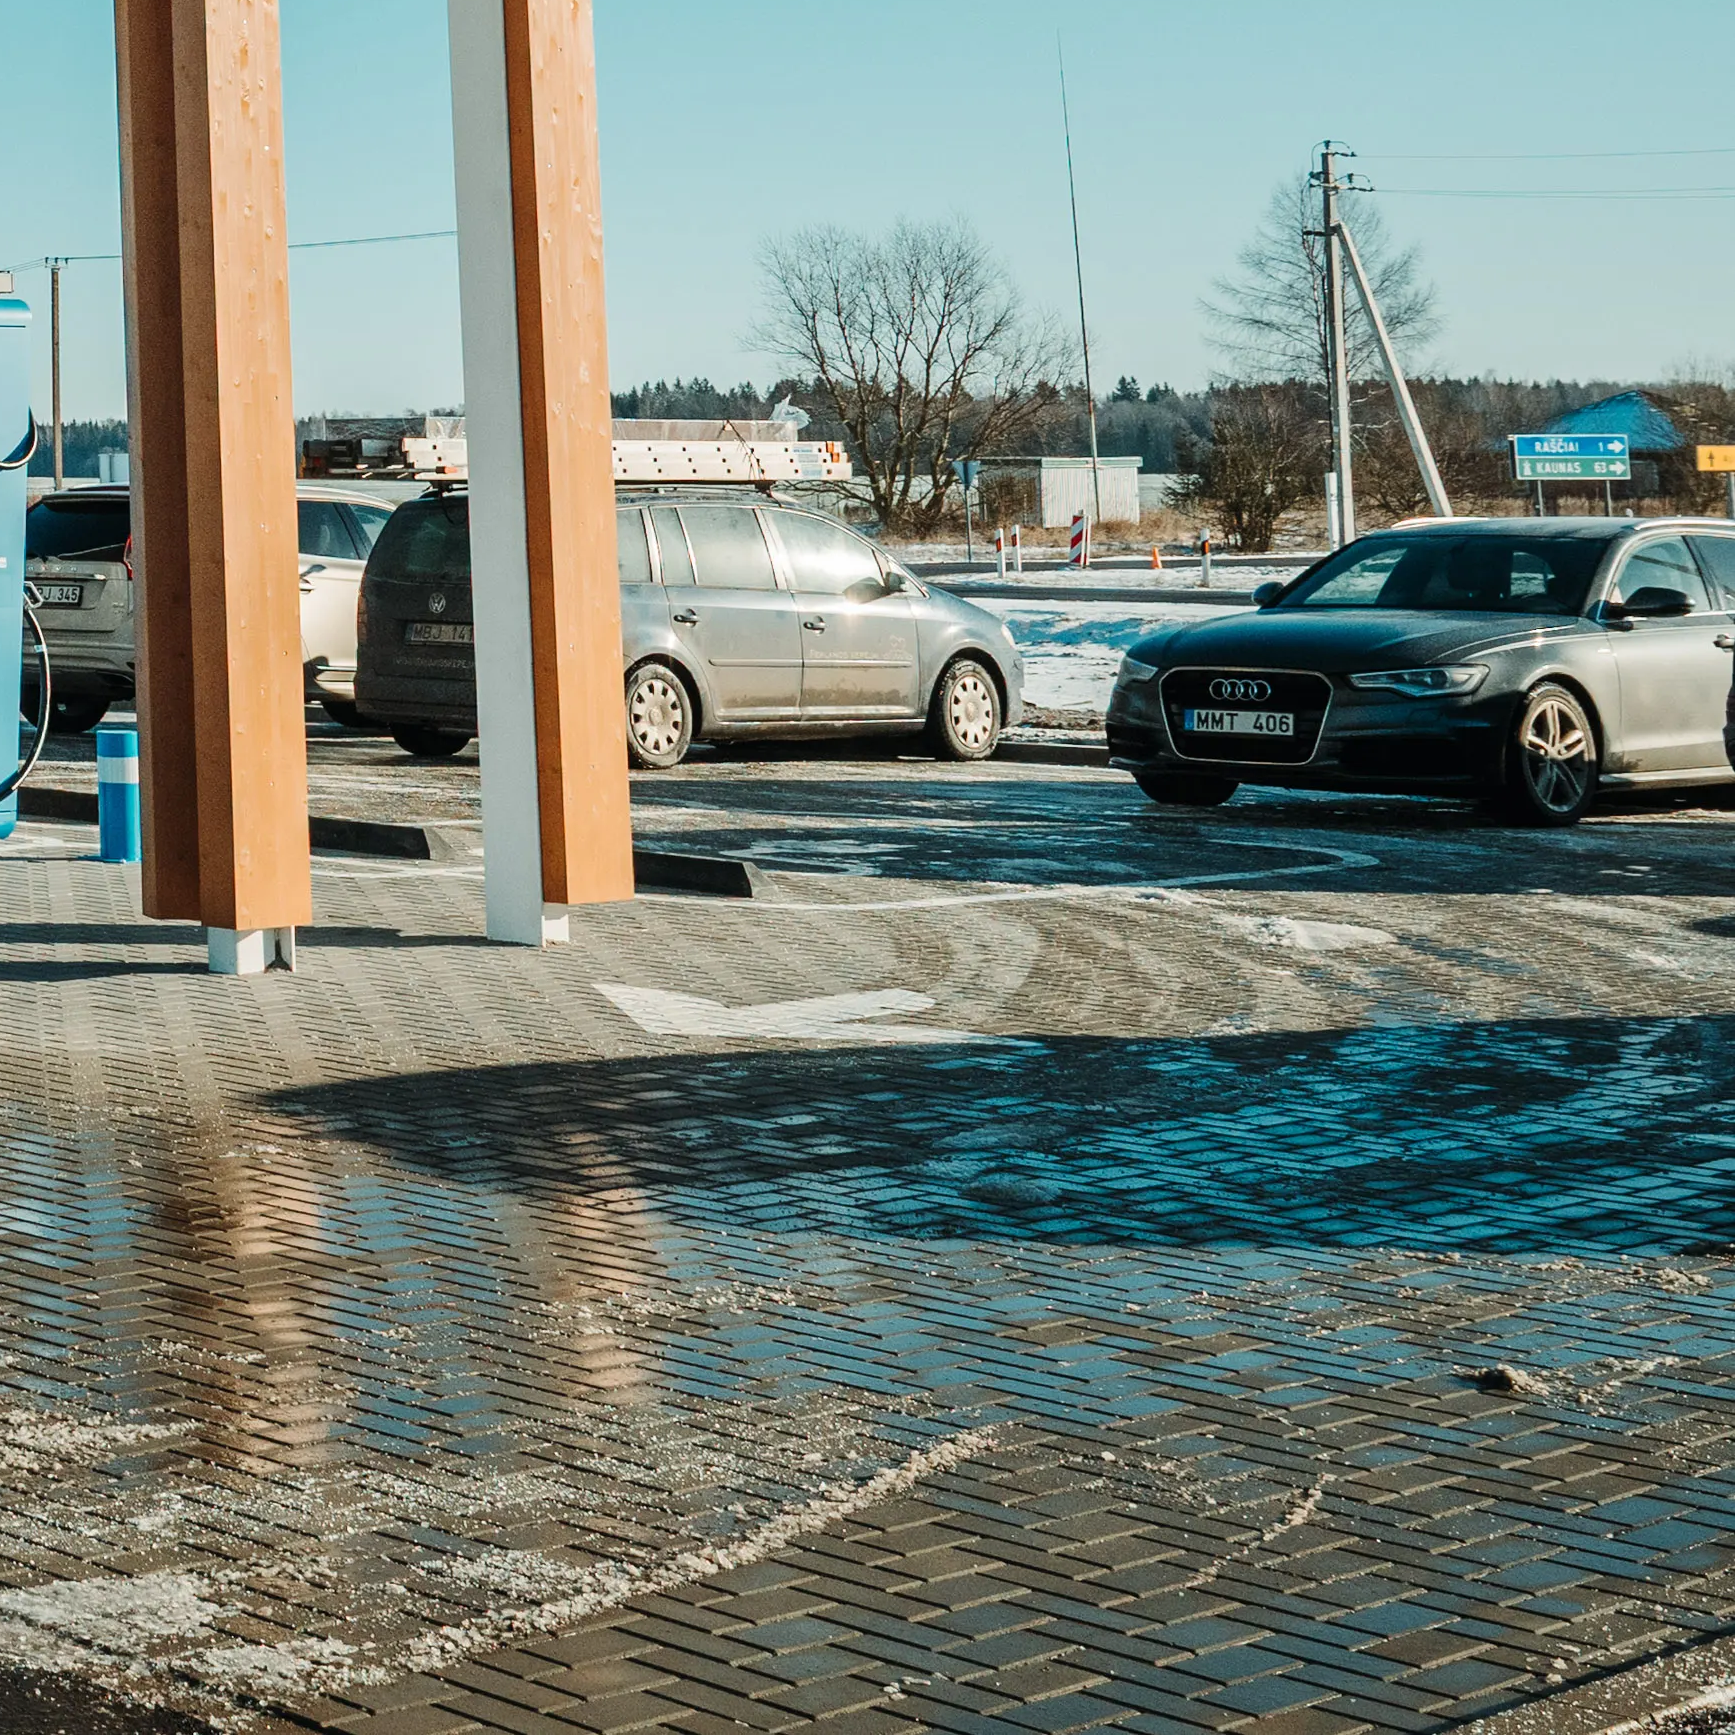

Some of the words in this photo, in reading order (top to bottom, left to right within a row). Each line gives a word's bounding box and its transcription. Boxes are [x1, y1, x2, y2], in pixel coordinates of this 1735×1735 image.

[1598, 441, 1604, 452] 1
[1536, 461, 1582, 474] KAUNAS
[1594, 461, 1607, 474] 63
[57, 587, 78, 602] 345
[413, 624, 442, 640] MBJ
[1196, 711, 1239, 731] MMT
[1252, 713, 1290, 733] 406
